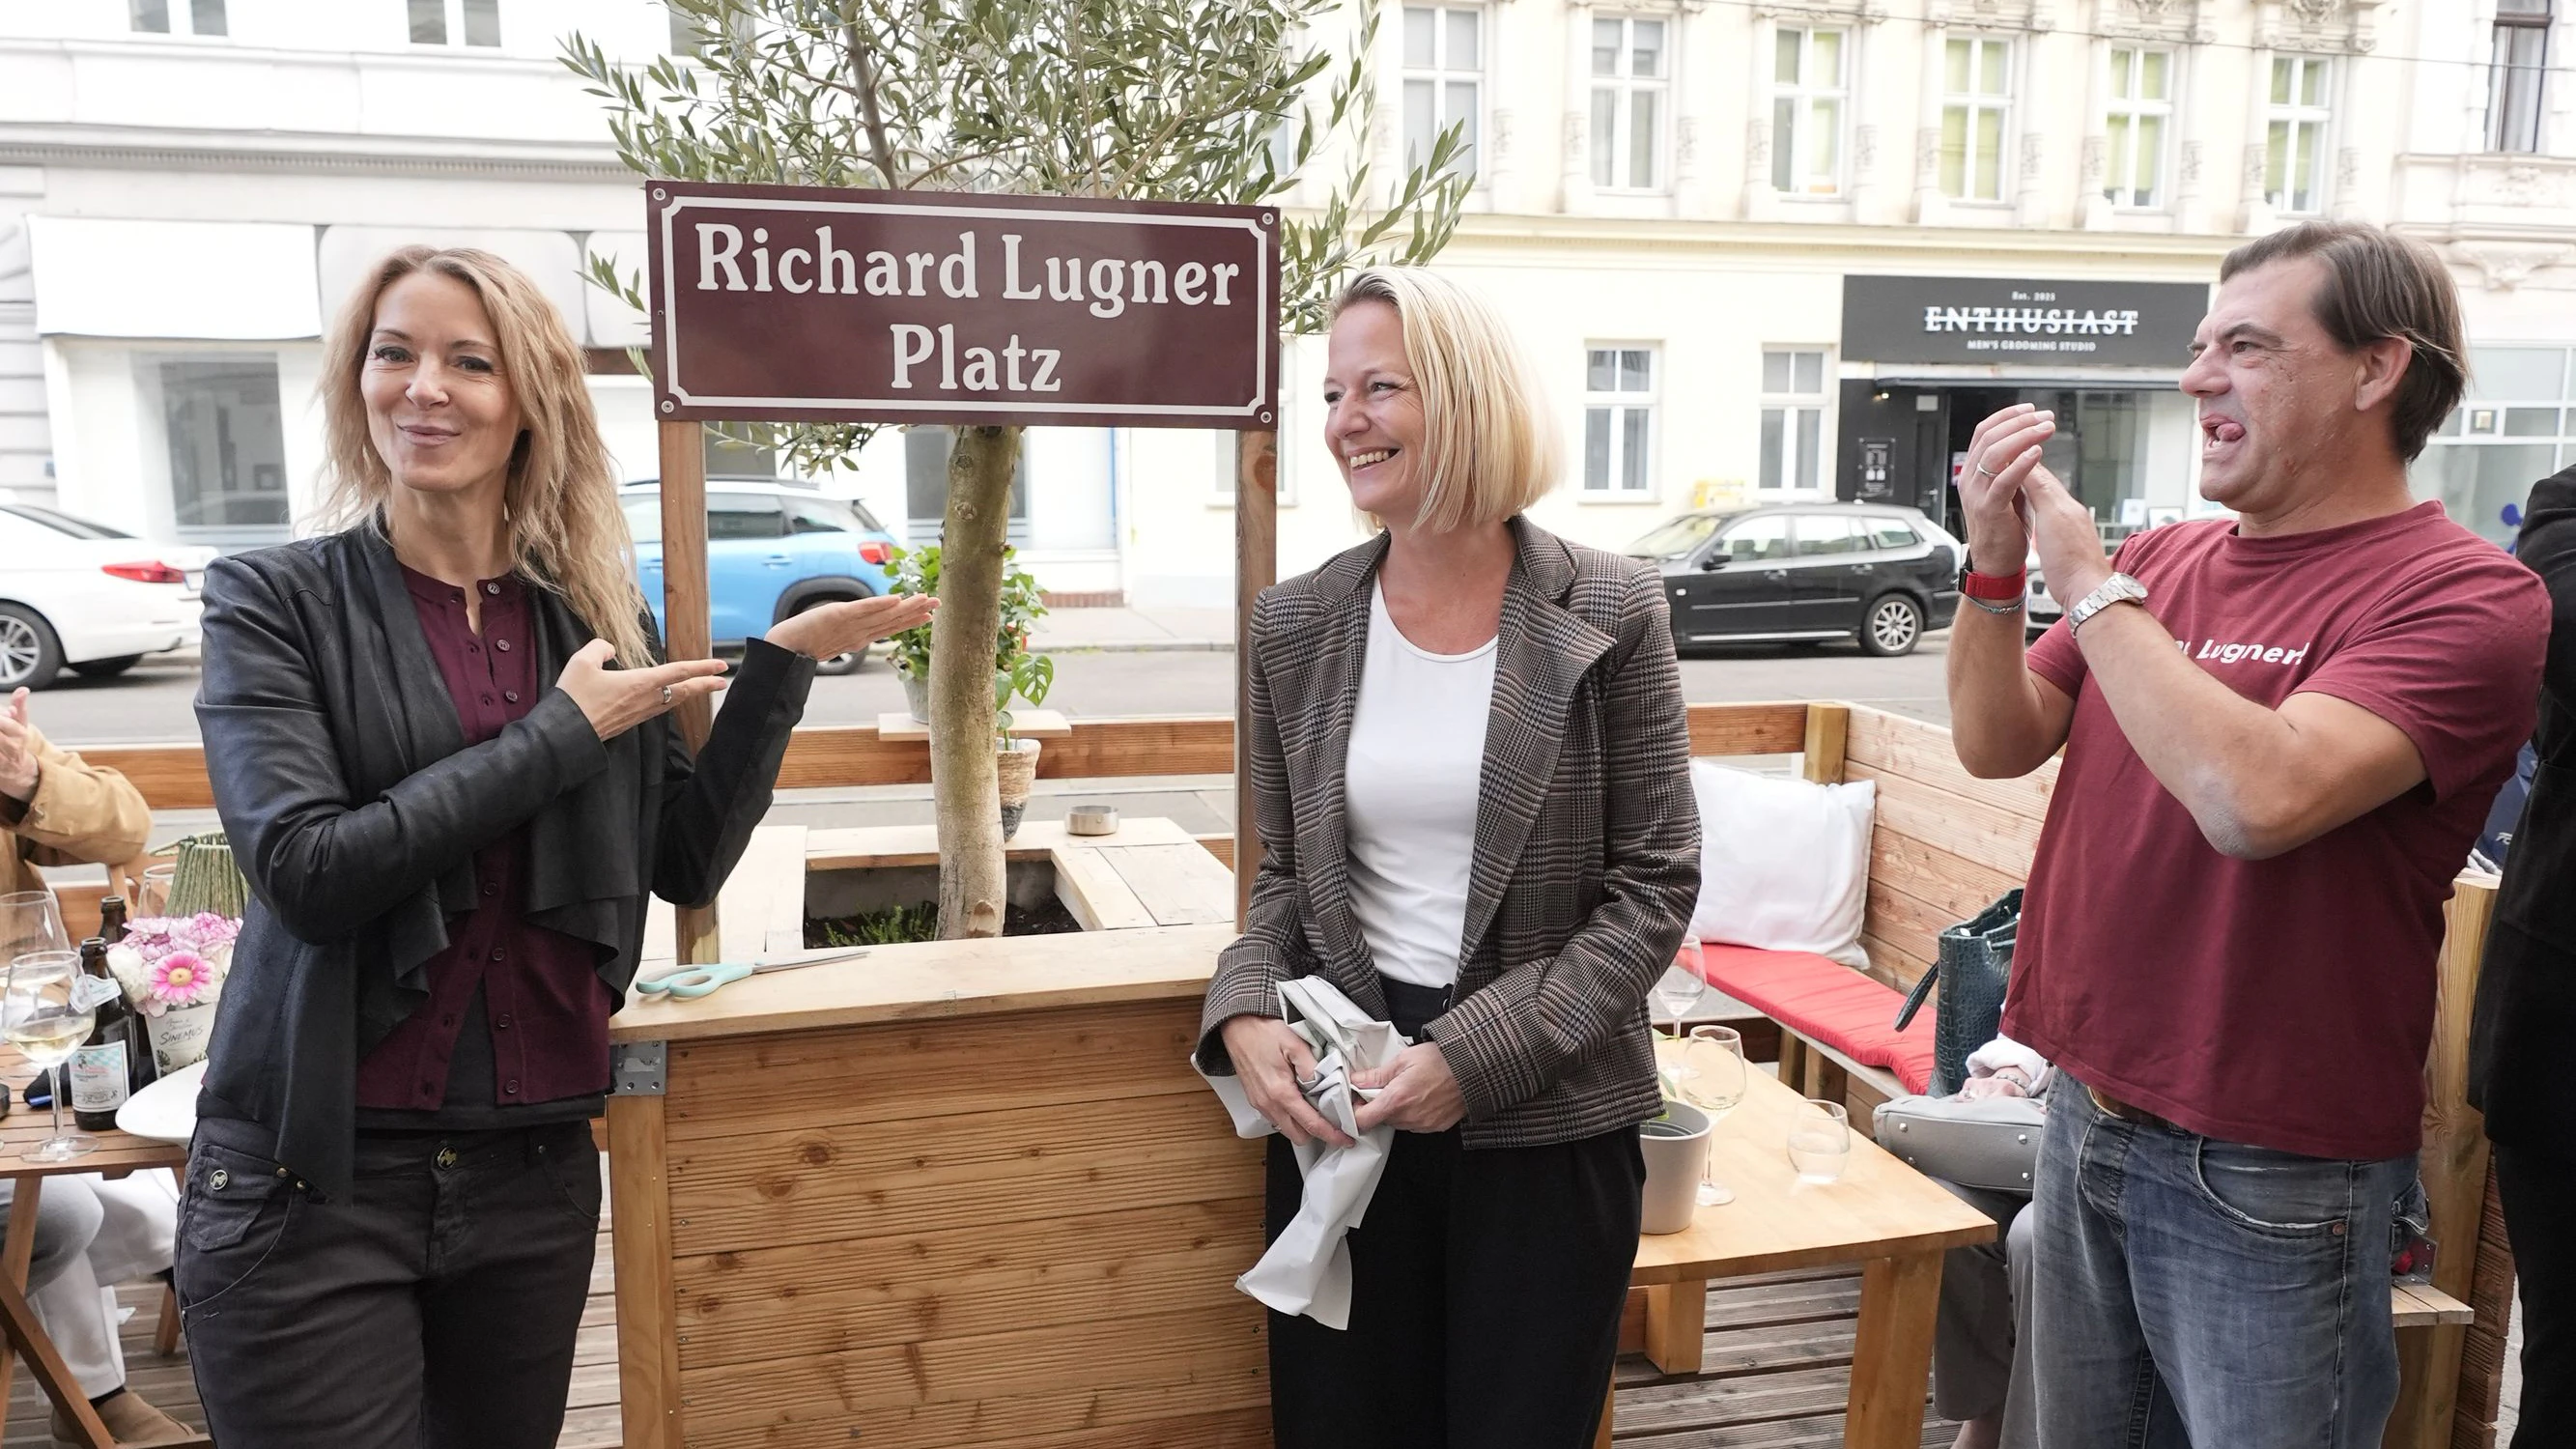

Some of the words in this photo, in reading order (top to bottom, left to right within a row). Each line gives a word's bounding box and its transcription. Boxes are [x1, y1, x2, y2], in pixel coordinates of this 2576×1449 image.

[694, 221, 980, 299] Richard
[1001, 234, 1240, 320] Lugner
[2011, 290, 2030, 300] Est.
[1923, 305, 2139, 335] ENTHUSIAST
[889, 323, 1062, 392] Platz
[1967, 339, 1999, 351] MEN'S
[2000, 339, 2057, 352] GROOMING
[2058, 341, 2097, 353] STUDIO
[2195, 639, 2310, 666] Lugner!
